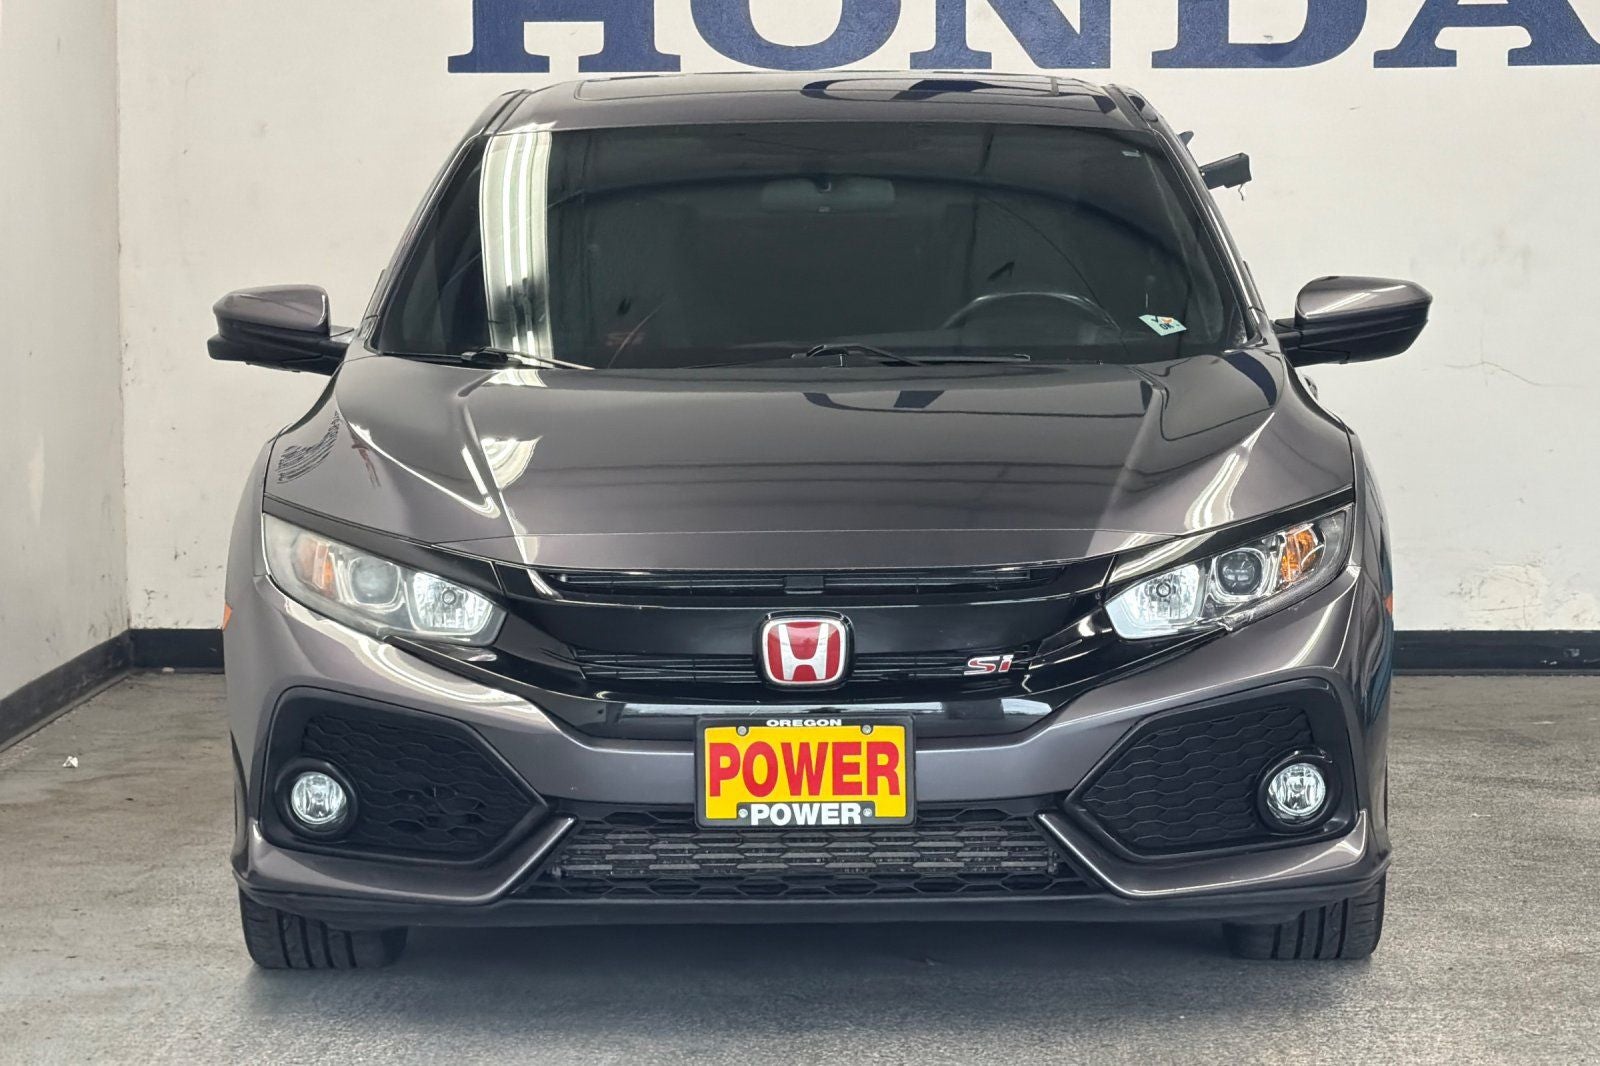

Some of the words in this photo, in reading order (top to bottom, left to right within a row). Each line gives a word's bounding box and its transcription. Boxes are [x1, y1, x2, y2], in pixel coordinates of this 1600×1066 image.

[766, 719, 842, 727] OREGON
[709, 741, 900, 797] POWER
[751, 803, 862, 826] POWER
